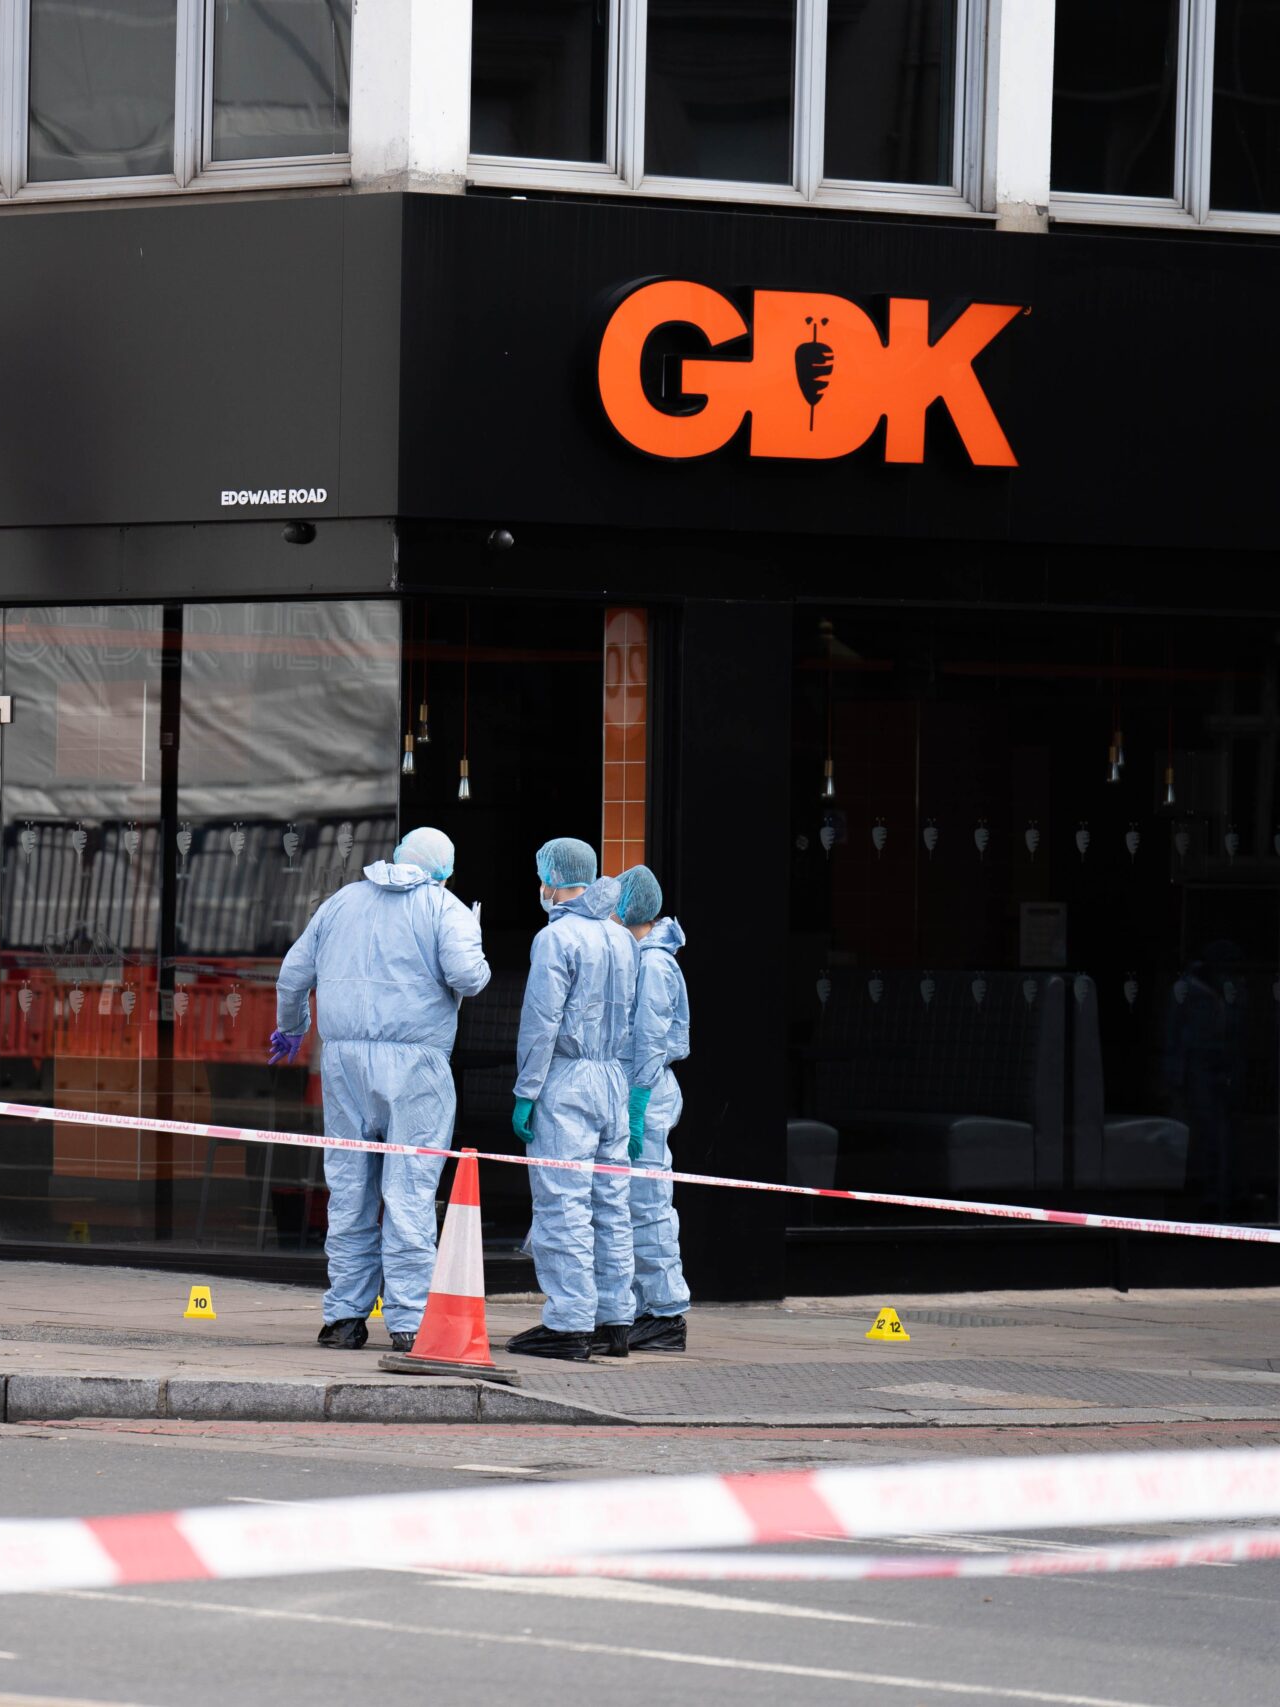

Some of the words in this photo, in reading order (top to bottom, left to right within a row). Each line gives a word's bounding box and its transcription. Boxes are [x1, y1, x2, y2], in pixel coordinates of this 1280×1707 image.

[598, 280, 1022, 467] GDK
[221, 489, 287, 505] EDGWARE
[288, 488, 328, 503] ROAD
[193, 1297, 208, 1309] 10
[876, 1319, 886, 1330] 12
[889, 1321, 901, 1333] 12
